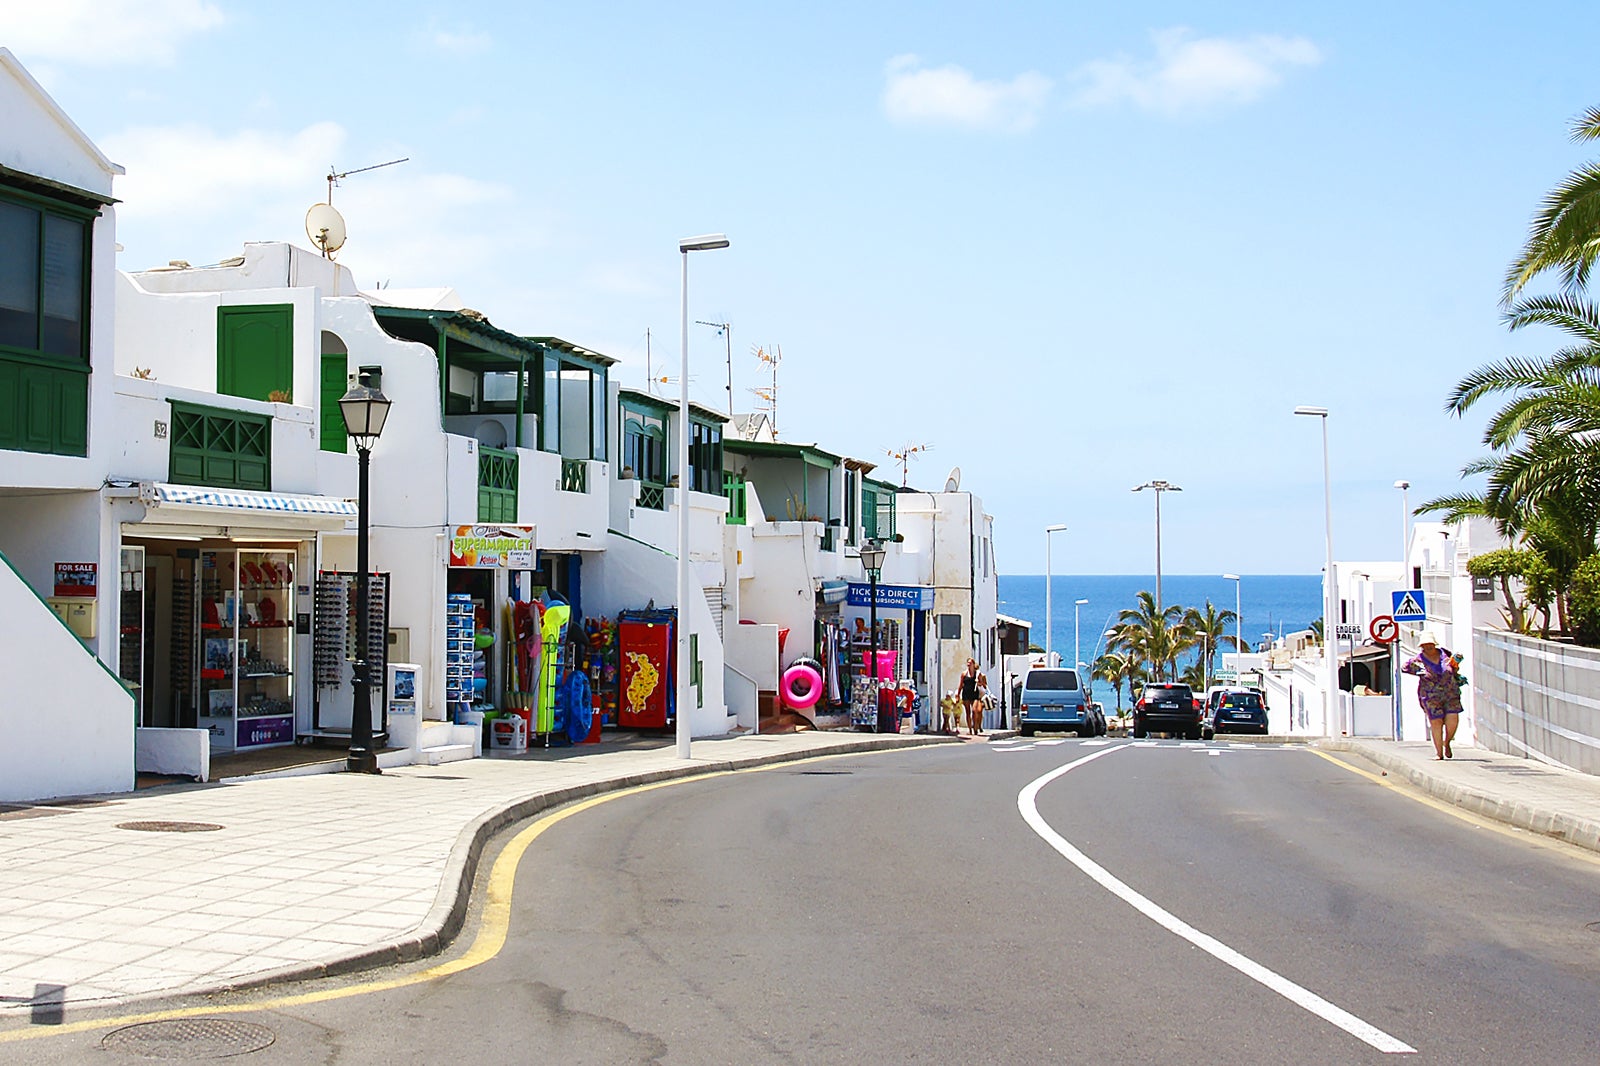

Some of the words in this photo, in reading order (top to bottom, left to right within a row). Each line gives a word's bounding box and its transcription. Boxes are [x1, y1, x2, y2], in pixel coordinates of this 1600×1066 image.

[156, 423, 166, 436] 32
[454, 537, 531, 551] SUPERMARKET
[851, 587, 885, 597] TICKTS
[887, 589, 919, 599] DIRECT
[863, 597, 905, 605] EXURSIONS
[1335, 625, 1361, 634] ENDERS
[209, 729, 225, 737] OTUS
